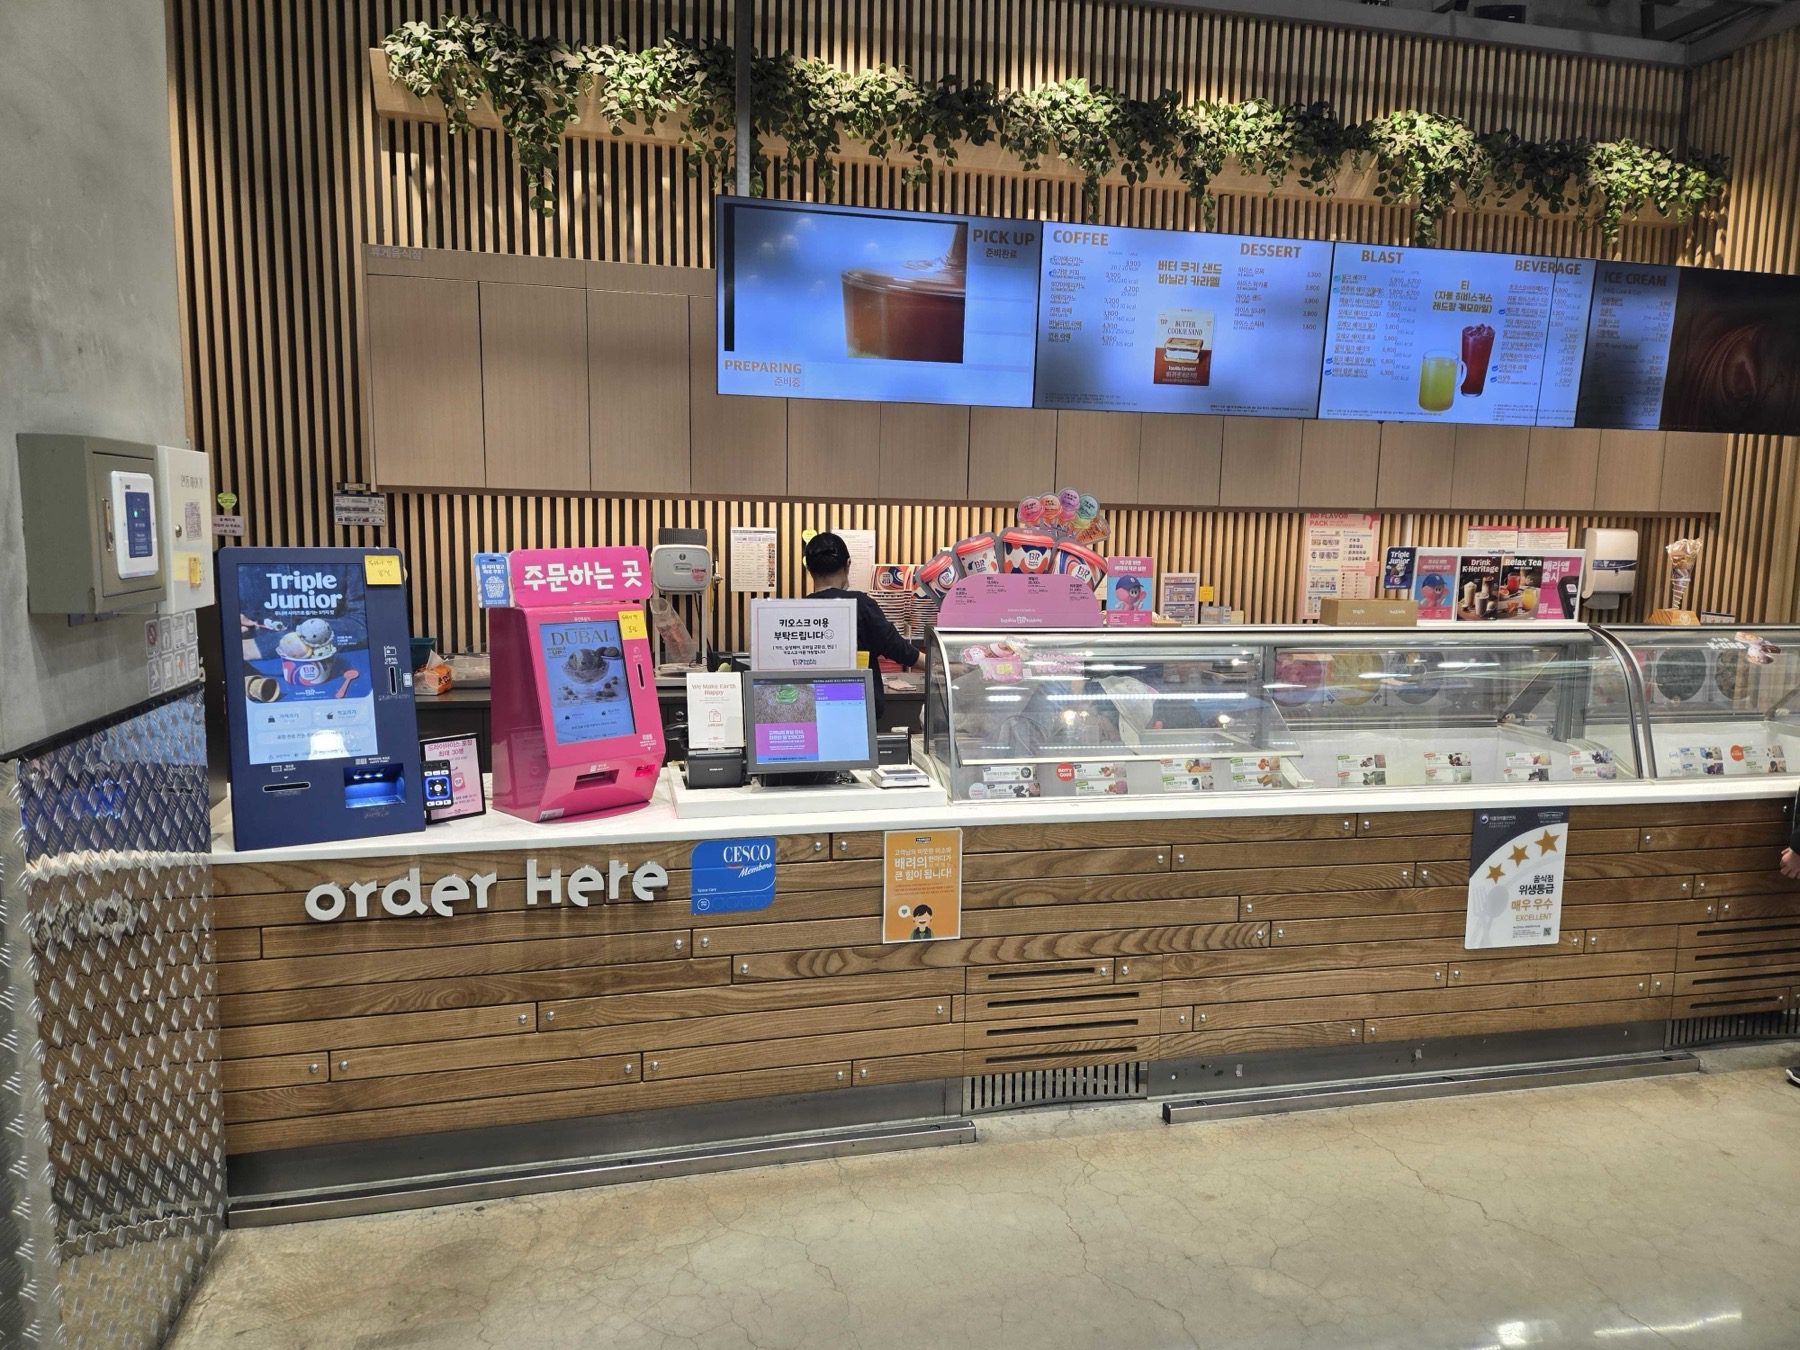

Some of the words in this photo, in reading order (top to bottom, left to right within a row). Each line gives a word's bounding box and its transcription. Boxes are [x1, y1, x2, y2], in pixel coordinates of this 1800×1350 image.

[973, 229, 1008, 245] PICK
[1013, 231, 1035, 246] UP
[1053, 230, 1109, 246] COFFEE
[985, 247, 1017, 259] 준비완료
[1240, 243, 1302, 258] DESSERT
[1361, 250, 1404, 265] BLAST
[1158, 260, 1178, 271] 버터
[1180, 261, 1200, 273] 쿠키
[1202, 263, 1222, 274] 샌드
[1514, 259, 1582, 275] BEVERAGE
[1158, 273, 1187, 286] 바닐라
[1190, 275, 1220, 288] 카라멜
[1461, 280, 1470, 290] 티
[1604, 272, 1623, 284] ICE
[1626, 272, 1667, 287] CREAM
[1456, 291, 1493, 302] 히비스커스
[1458, 302, 1493, 313] 캐모마일)
[724, 359, 802, 374] PREPARING
[774, 376, 801, 388] 준비중
[1029, 552, 1040, 561] BR
[1388, 557, 1410, 565] Junior
[1390, 550, 1410, 559] Triple
[974, 559, 985, 568] BR
[1505, 558, 1527, 566] Relax
[1528, 558, 1542, 566] Tea
[1543, 560, 1570, 572] 배라앱
[523, 561, 615, 592] 주문하는
[621, 559, 643, 588] 곳
[1077, 566, 1090, 579] BR
[1462, 565, 1499, 573] K-Heritage
[265, 570, 338, 592] Triple
[1542, 569, 1559, 583] 출시
[264, 590, 343, 609] Junior
[778, 618, 811, 628] 키오스크
[813, 617, 829, 628] 이용
[551, 629, 608, 646] DUBAI
[774, 631, 824, 641] 부탁드립니다
[704, 689, 724, 697] Happy
[428, 741, 460, 752] 드라이아이스
[722, 844, 771, 864] CESCO
[895, 855, 927, 869] 배려의
[738, 861, 773, 879] Members
[895, 871, 904, 881] 큰
[905, 870, 922, 881] 힘이
[923, 868, 952, 880] 됩니다!
[1533, 874, 1554, 884] 음식점
[304, 863, 498, 922] order
[526, 858, 669, 908] Here
[1518, 883, 1554, 896] 위생등급
[1511, 899, 1532, 911] 매우
[1533, 898, 1553, 910] 우수
[1515, 913, 1552, 922] EXCELLENT
